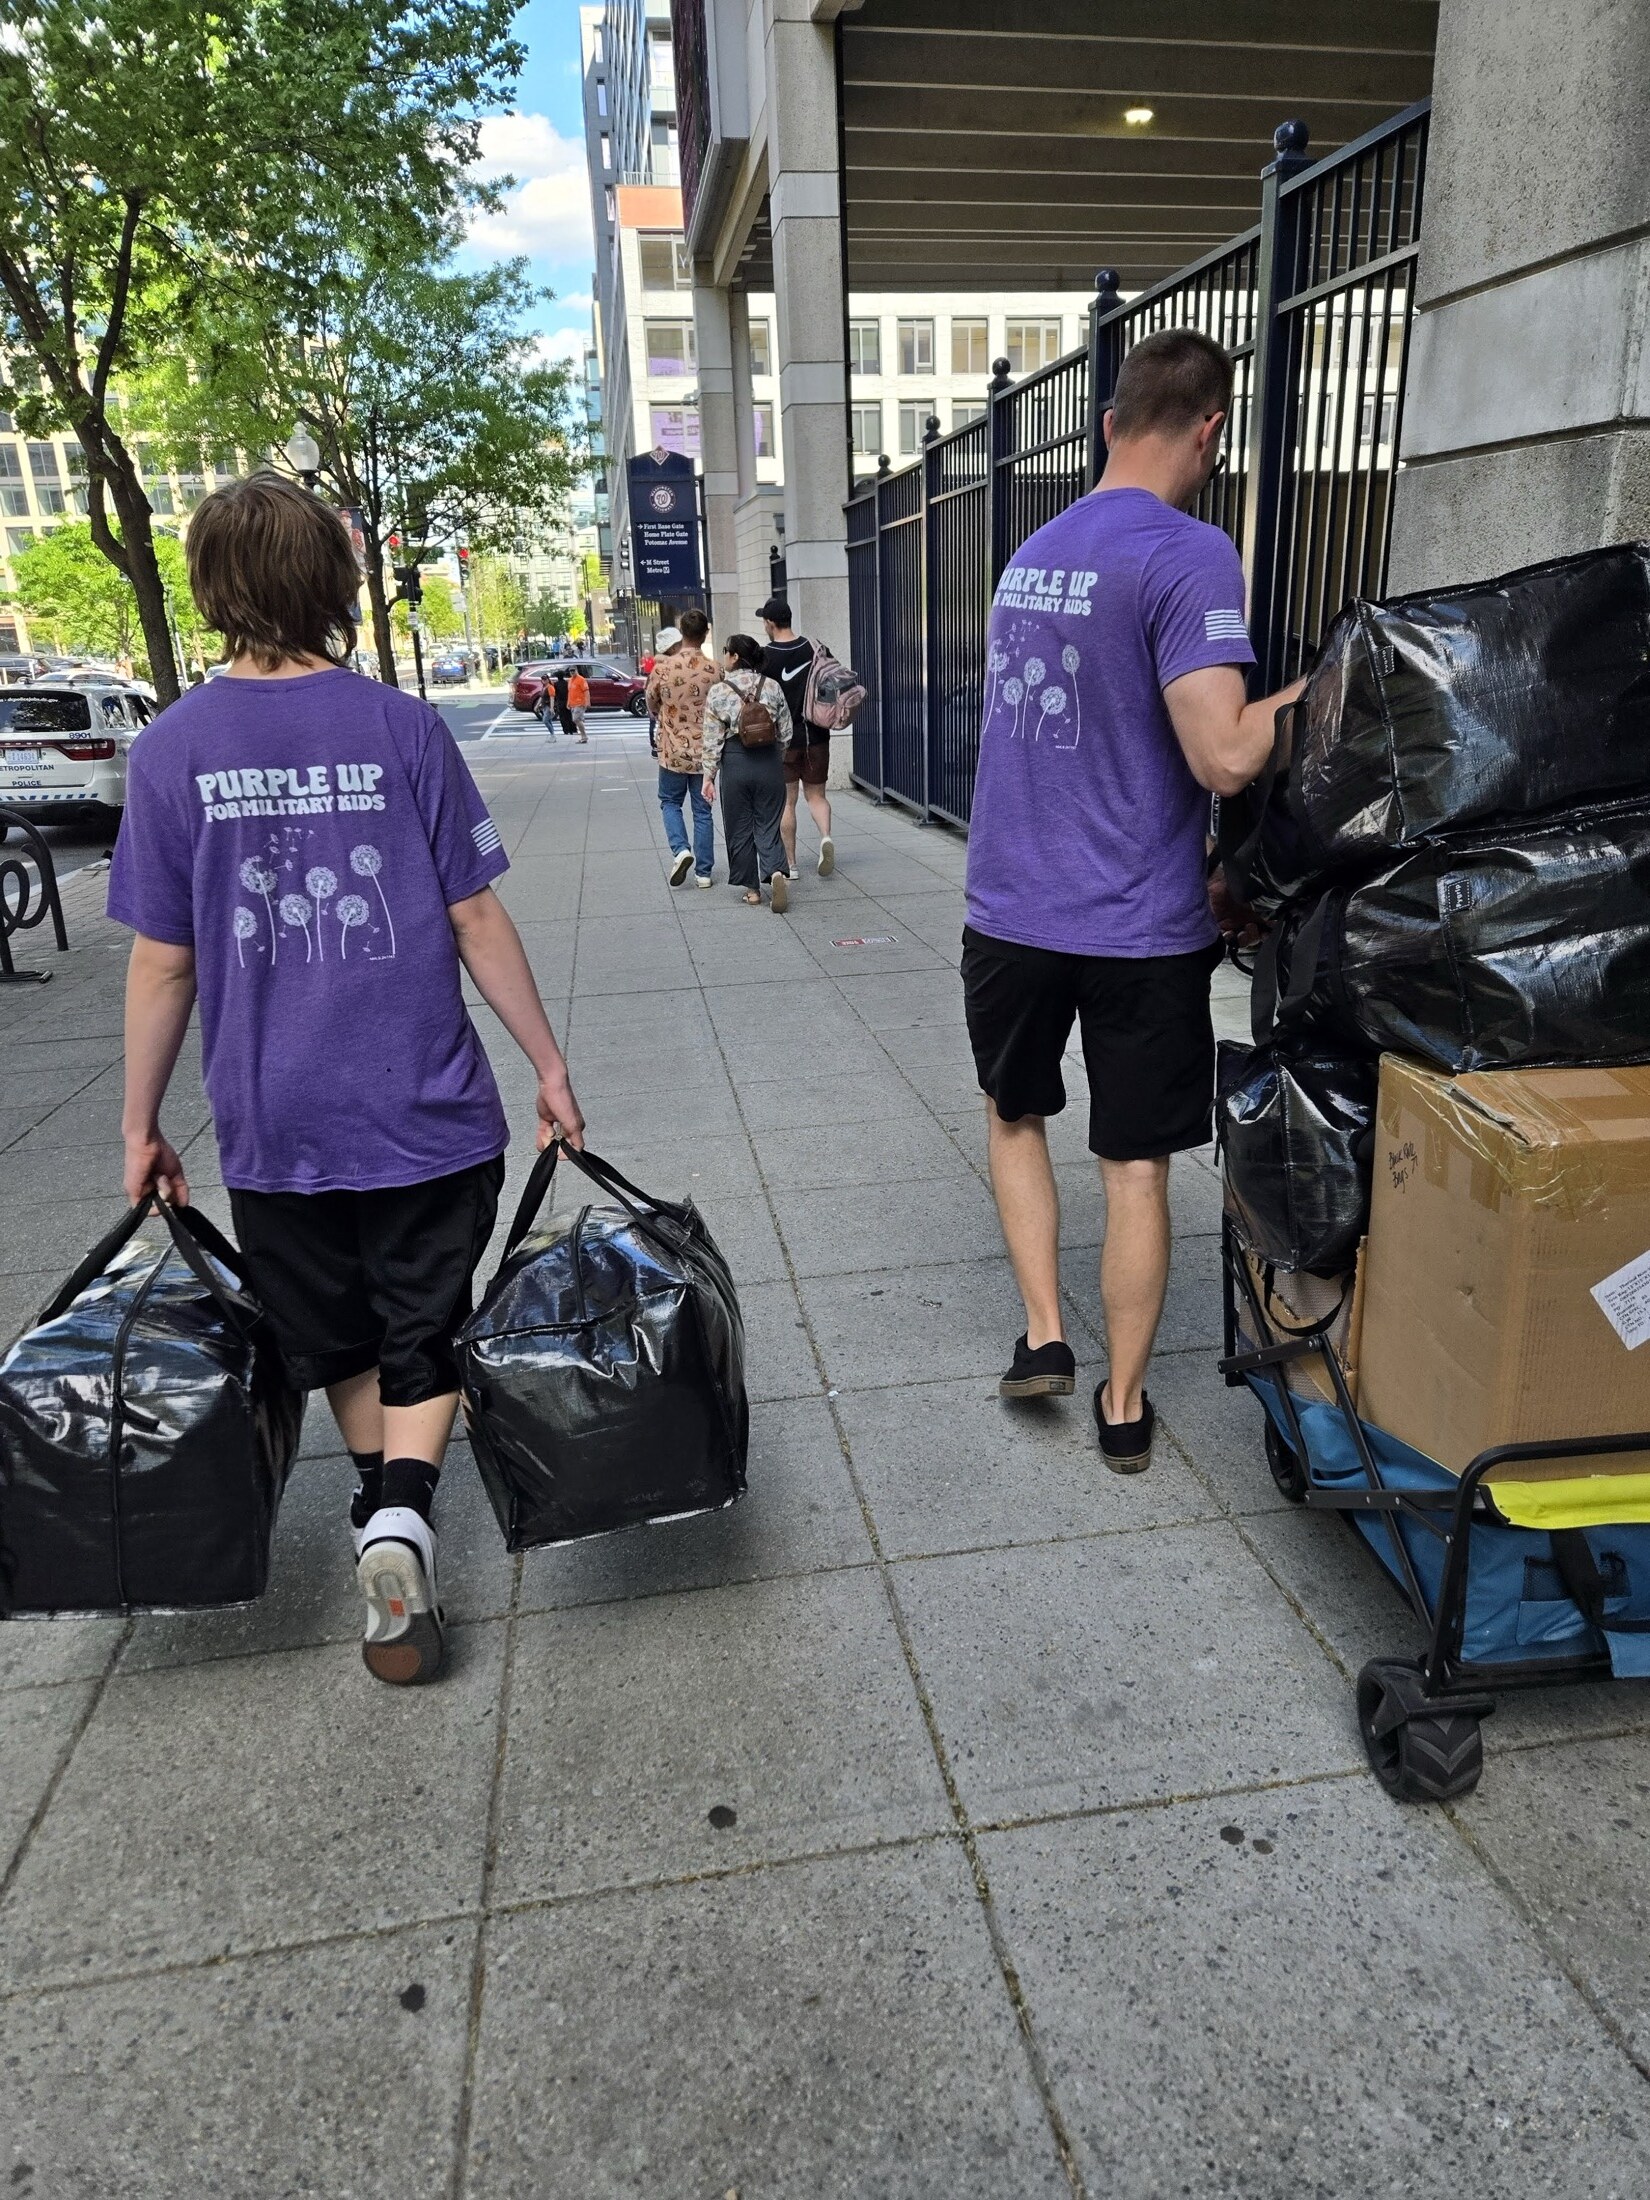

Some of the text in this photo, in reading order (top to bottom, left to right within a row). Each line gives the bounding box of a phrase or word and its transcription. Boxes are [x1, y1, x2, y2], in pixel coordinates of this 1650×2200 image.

[1071, 571, 1098, 597] UP
[1001, 594, 1062, 612] MILITARY
[1063, 598, 1093, 616] KIDS
[195, 764, 384, 804] PURPLE UP
[204, 793, 386, 823] FOR MILITARY KIDS
